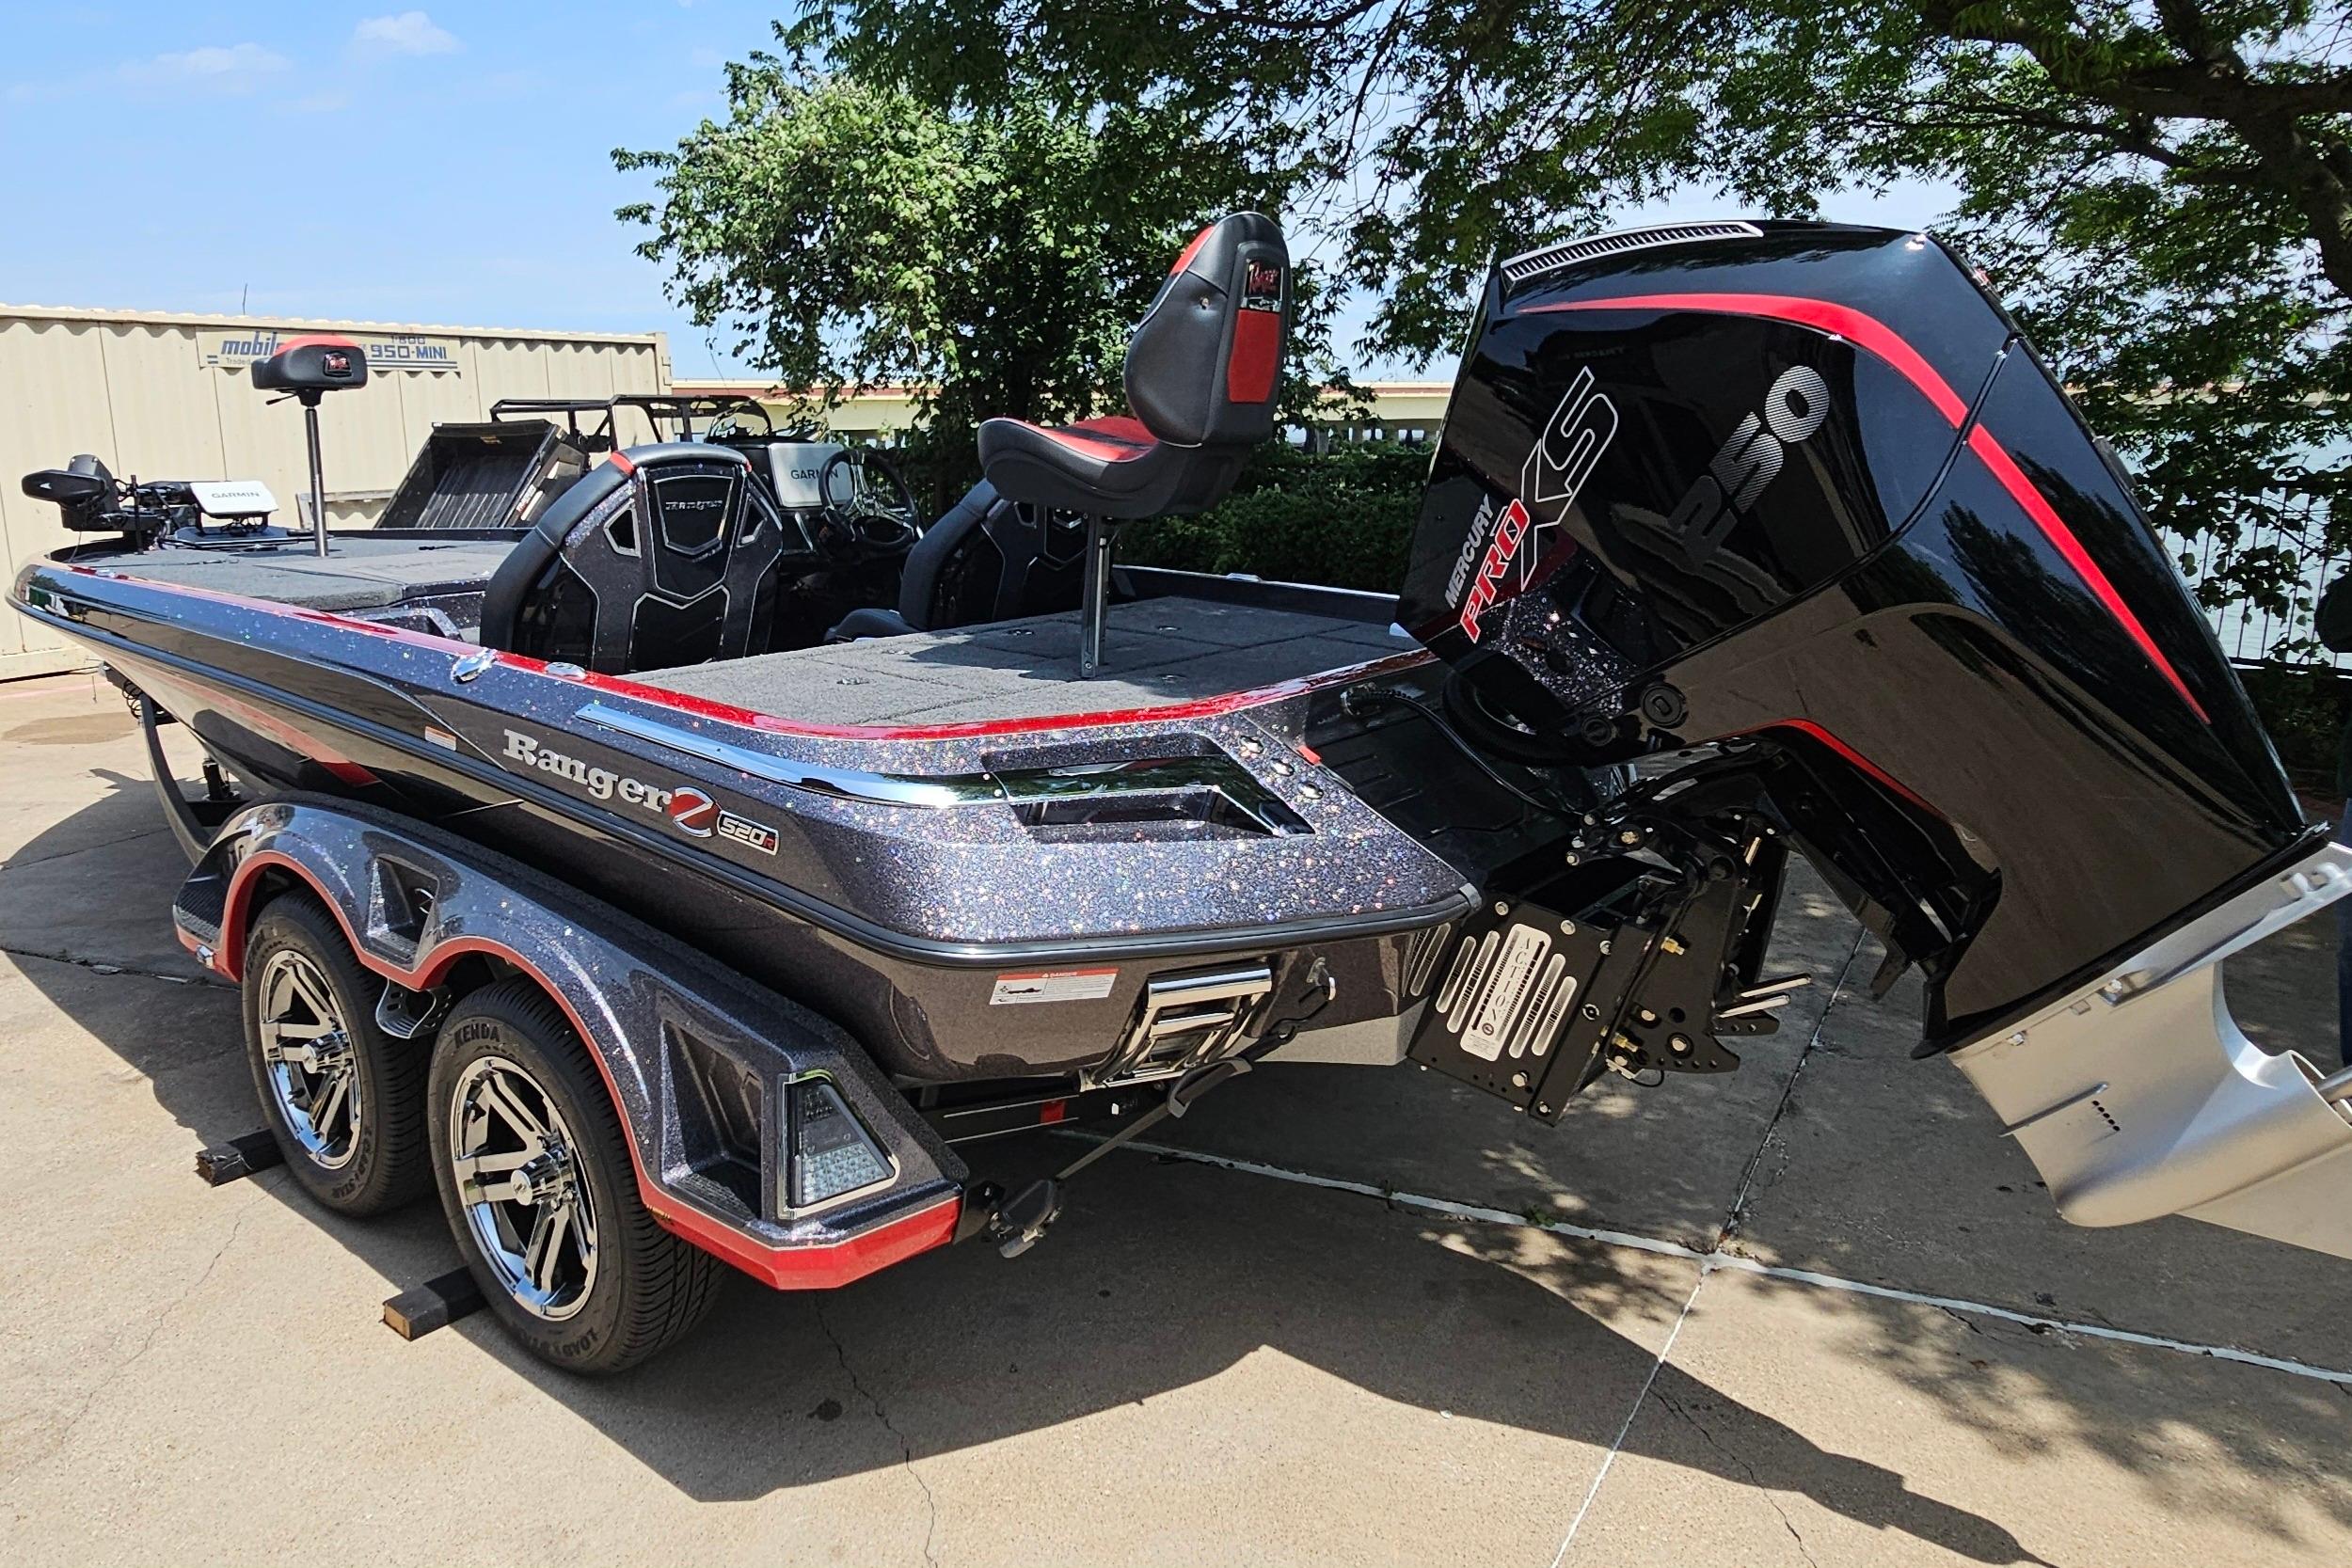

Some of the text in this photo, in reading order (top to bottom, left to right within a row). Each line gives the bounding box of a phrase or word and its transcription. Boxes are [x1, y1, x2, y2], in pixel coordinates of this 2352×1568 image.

[790, 469, 839, 480] GARN
[1489, 365, 1619, 593] XS
[1668, 365, 1830, 562] 250
[1444, 493, 1494, 609] MERCURY
[1460, 498, 1530, 644] PRO
[502, 728, 673, 813] Ranger
[453, 1022, 501, 1049] KENDA
